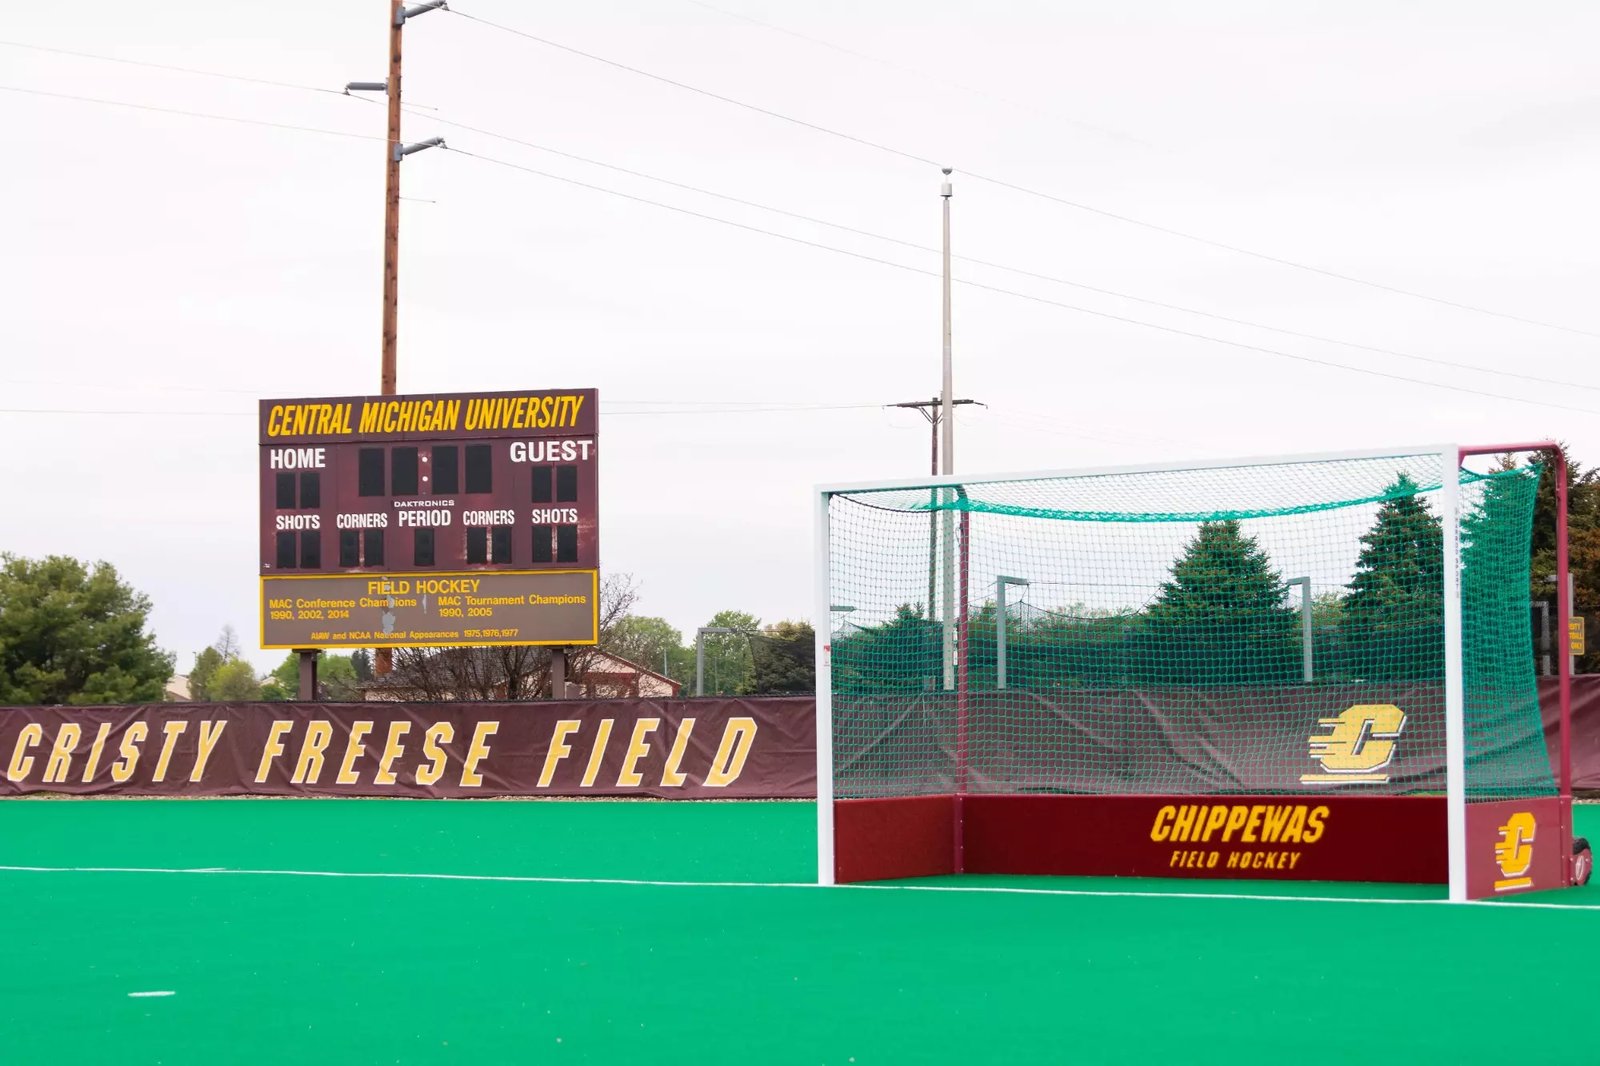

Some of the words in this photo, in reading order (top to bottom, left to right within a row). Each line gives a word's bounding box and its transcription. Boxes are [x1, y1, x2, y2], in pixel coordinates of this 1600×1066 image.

[267, 402, 353, 437] CENTRAL
[359, 399, 461, 434] MICHIGAN
[464, 395, 585, 430] UNIVERSITY
[270, 447, 326, 469] HOME
[510, 439, 593, 463] GUEST
[394, 499, 455, 508] DAKTRONICS
[275, 515, 321, 530] SHOTS
[336, 513, 388, 528] CORNERS
[398, 510, 452, 527] PERIOD
[463, 510, 515, 526] CORNERS
[532, 509, 578, 524] SHOTS
[368, 581, 411, 595] FIELD
[416, 579, 480, 594] HOCKEY
[269, 599, 292, 609] MAC
[296, 598, 356, 609] Conference
[359, 597, 417, 609] Chamions
[438, 596, 461, 606] MAC
[465, 595, 525, 605] Tournament
[528, 594, 587, 606] Champions
[328, 610, 349, 619] 2014
[467, 607, 493, 617] 2005
[332, 632, 347, 640] and
[349, 631, 371, 640] NCAA
[409, 630, 459, 640] Appearances
[8, 720, 228, 783] CRISTY
[254, 720, 501, 787] FREESE
[537, 717, 759, 788] FIELD
[1150, 804, 1330, 844] CHIPPEWAS
[1169, 850, 1218, 869] FIELD
[1226, 850, 1302, 870] HOCKEY
